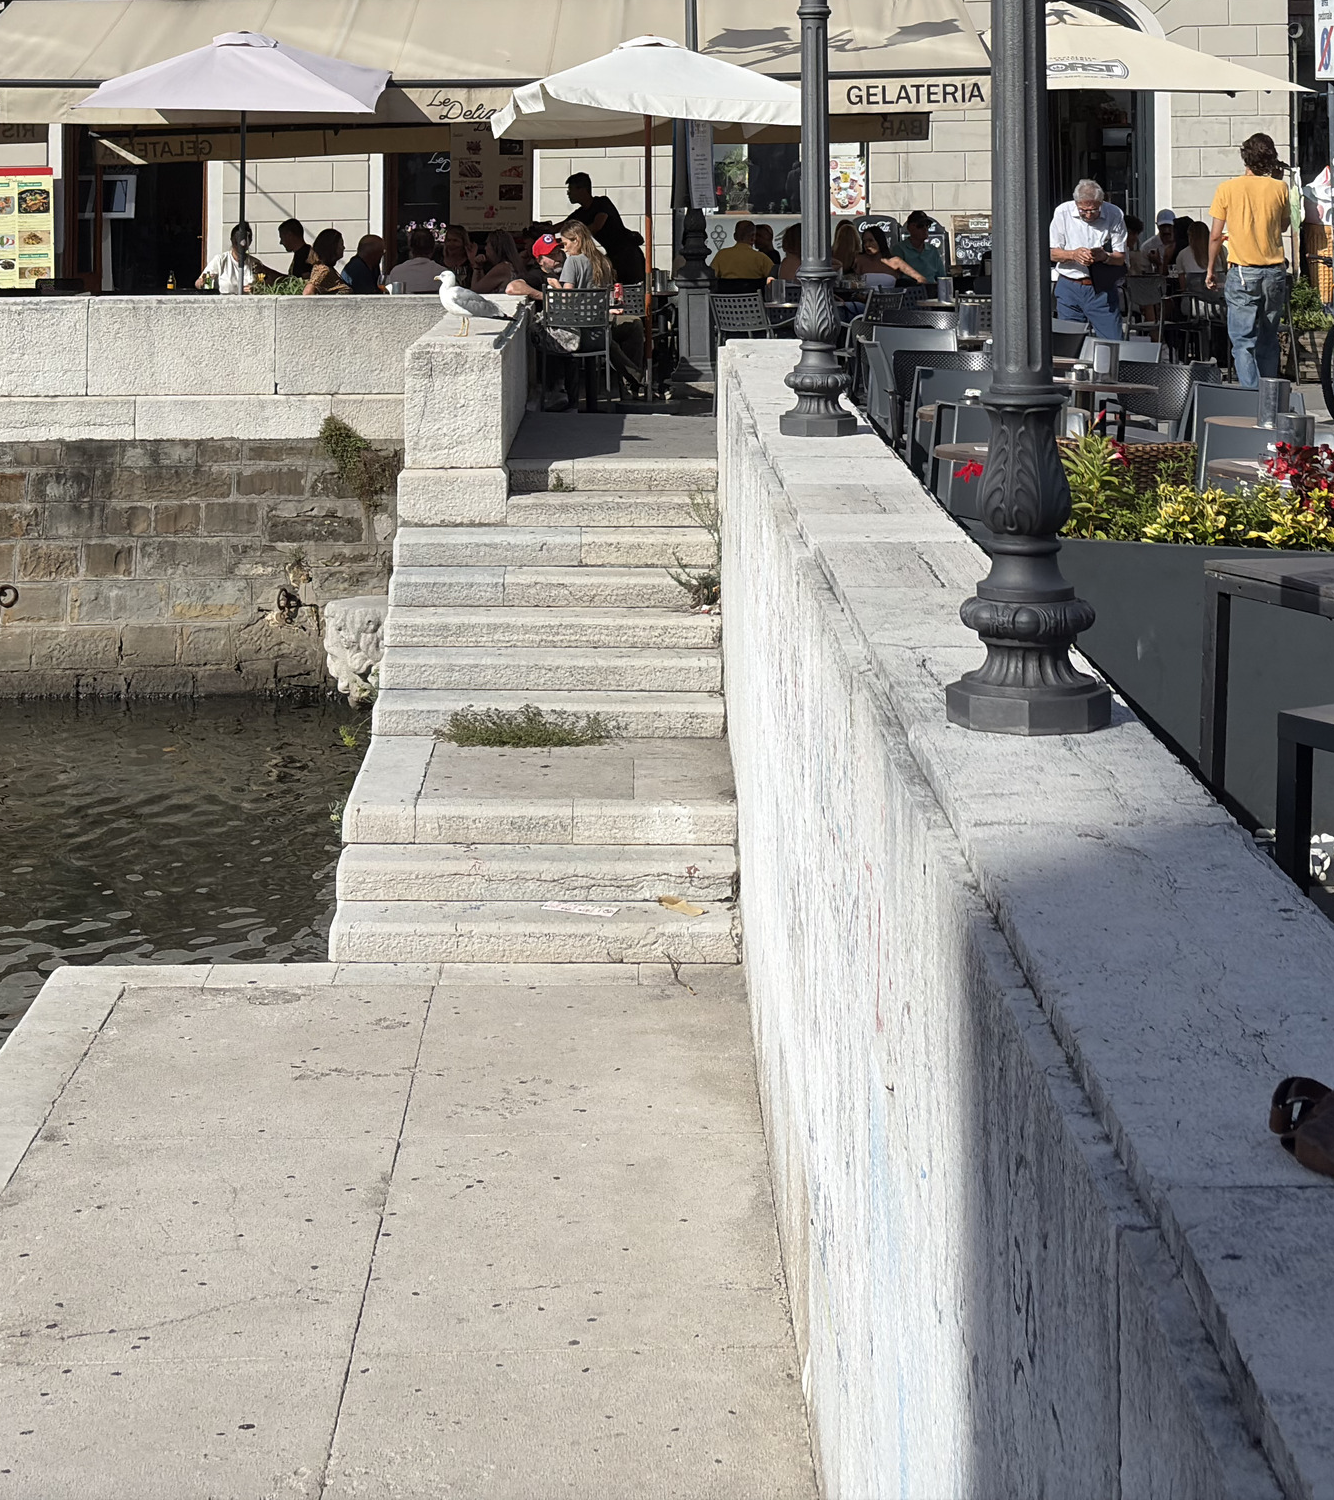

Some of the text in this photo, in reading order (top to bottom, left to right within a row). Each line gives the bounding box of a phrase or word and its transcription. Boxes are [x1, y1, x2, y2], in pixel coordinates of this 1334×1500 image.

[1046, 62, 1119, 73] ORST
[427, 90, 451, 107] Le
[846, 82, 985, 106] GELATERIA
